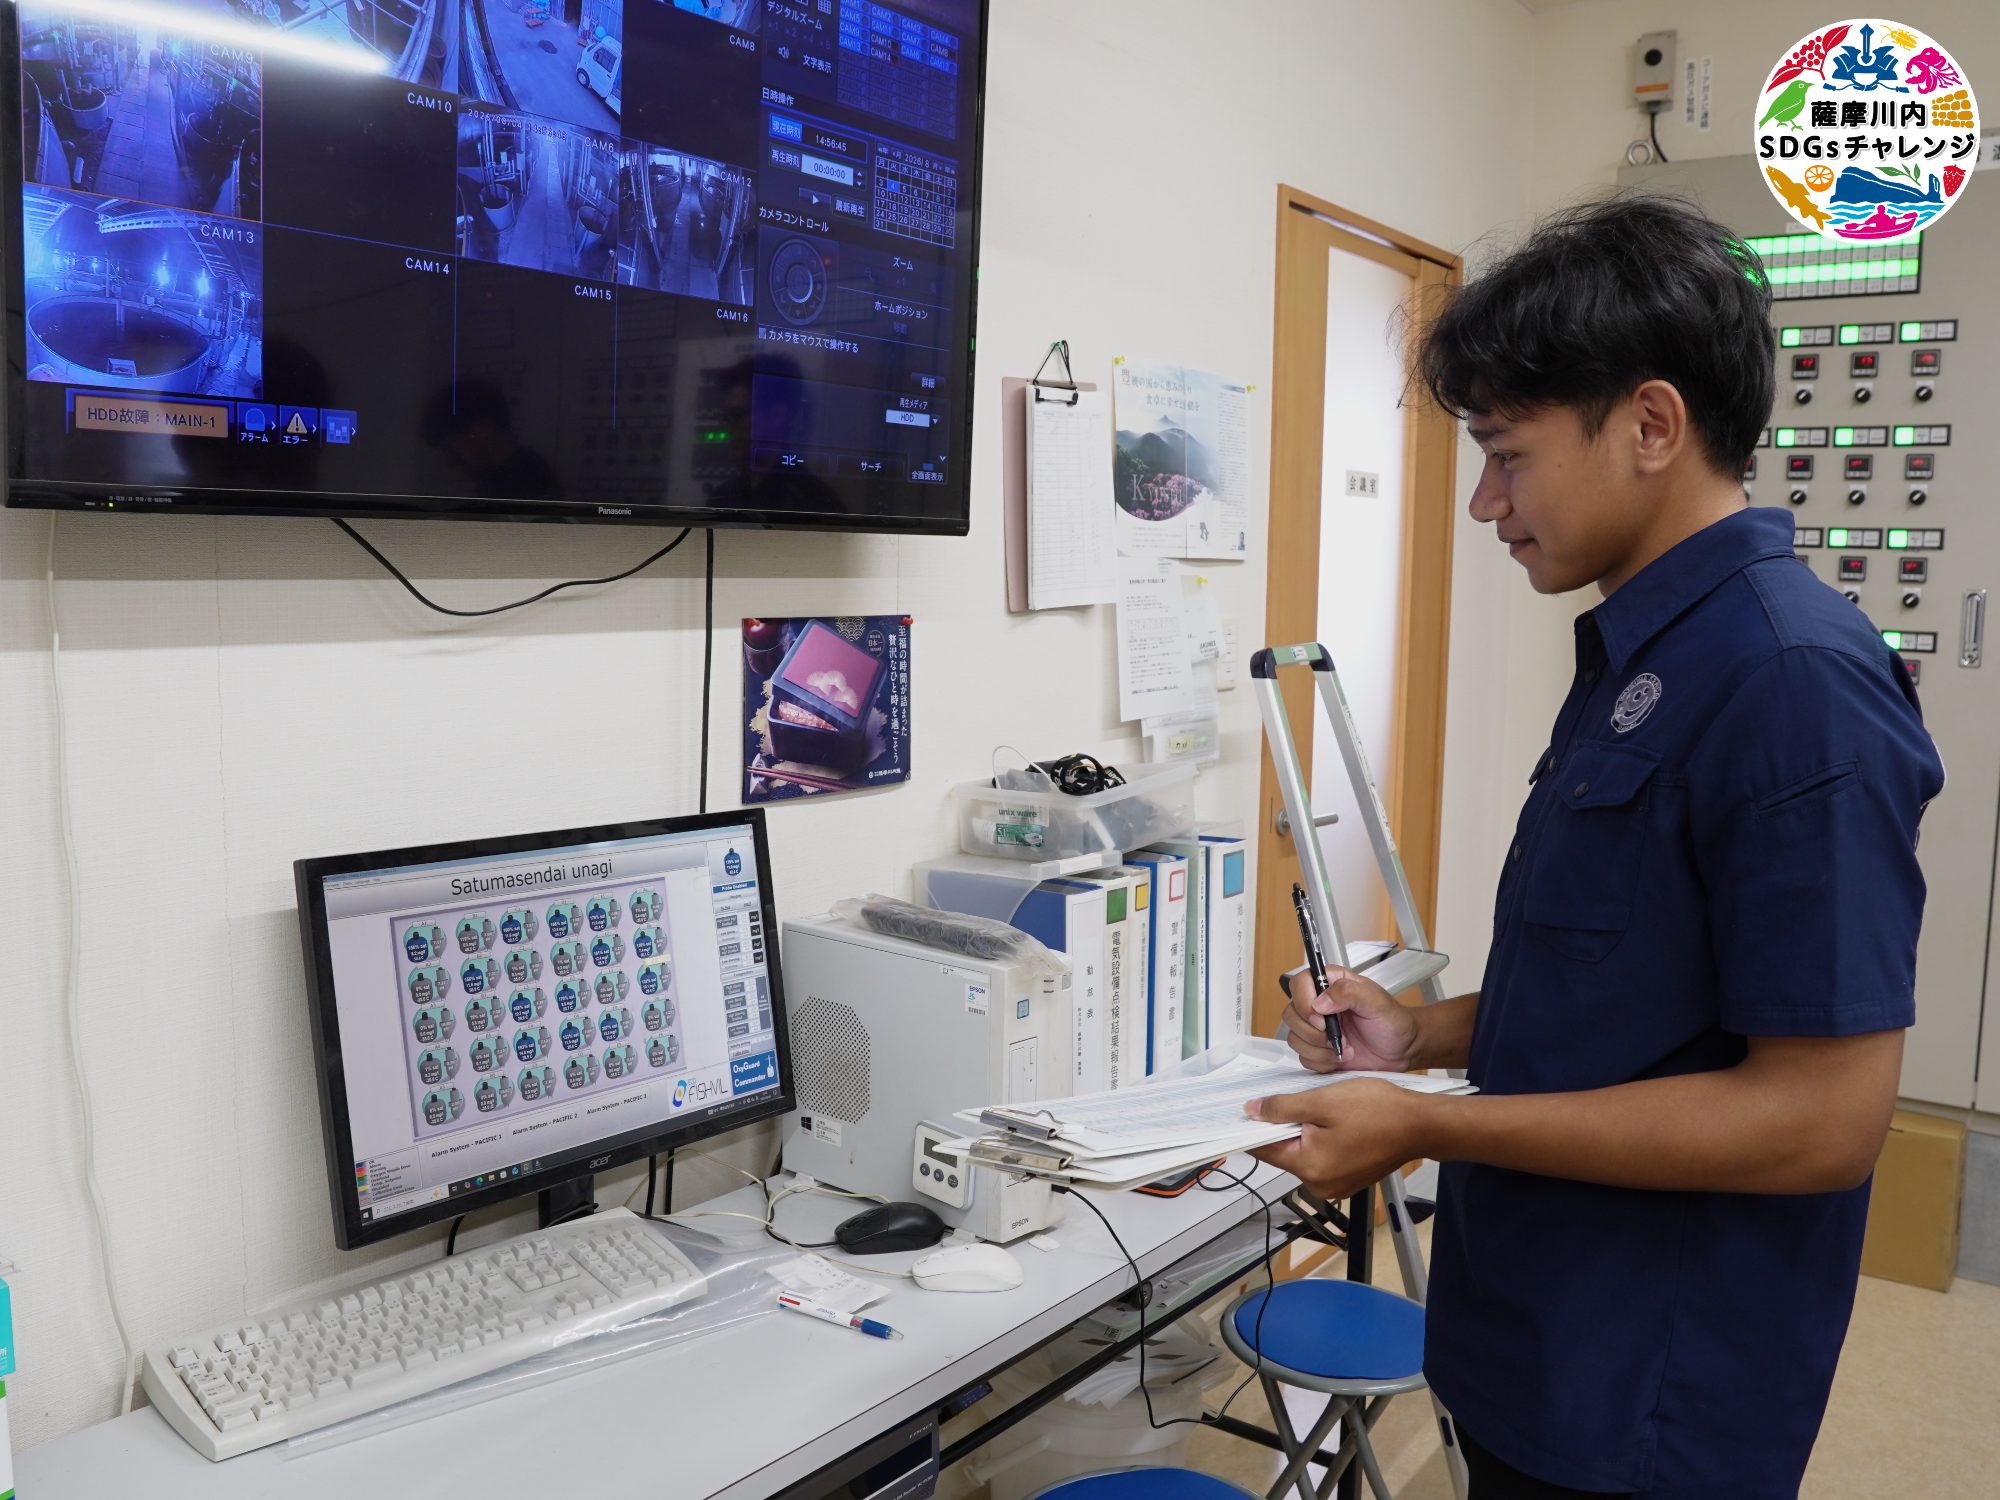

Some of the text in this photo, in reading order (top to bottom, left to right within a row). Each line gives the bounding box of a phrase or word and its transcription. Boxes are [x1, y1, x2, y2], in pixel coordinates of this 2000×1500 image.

[767, 1, 822, 30] デジタルズーム
[872, 6, 890, 21] CAM2
[902, 19, 920, 33] CAM3
[730, 35, 755, 51] CAM8
[871, 34, 891, 48] CAM10
[210, 44, 253, 64] CAM9
[871, 48, 890, 62] CAM14
[803, 55, 832, 73] 文字表示
[407, 92, 451, 112] CAM10
[762, 88, 794, 107] 日時操作
[773, 119, 801, 138] 現在時刻
[584, 137, 614, 153] CAM6
[816, 135, 846, 151] 14:56:45
[772, 149, 799, 167] 再生時刻
[814, 163, 846, 179] 00:00:00
[720, 171, 752, 187] CAM12
[877, 189, 885, 197] 10
[889, 192, 896, 200] 11
[836, 200, 865, 217] 最新再生
[759, 207, 829, 232] カメラコントロール
[876, 220, 883, 228] 31
[201, 225, 254, 244] CAM13
[405, 258, 449, 274] CAM14
[893, 258, 913, 270] ズーム
[575, 285, 611, 300] CAM15
[717, 308, 748, 322] CAM16
[875, 301, 928, 319] ホームポジション
[769, 330, 858, 353] カメラをマウスで操作する
[922, 377, 935, 388] 詳細
[900, 398, 927, 410] 再生メディア
[901, 413, 914, 422] HDD
[240, 433, 268, 442] アラーム
[283, 436, 308, 444] エラー
[782, 455, 804, 465] コピー
[861, 461, 881, 471] サーチ
[912, 471, 943, 481] 全画面表示
[599, 507, 631, 515] Panasonic
[898, 625, 908, 737] 至福の時間が詰まった
[889, 634, 899, 763] 贅沢なひと時を過ごそう
[999, 808, 1015, 816] unix
[451, 860, 613, 896] Satumasendai unagi
[970, 986, 985, 994] EPSON
[733, 1061, 760, 1073] OxyGuard
[735, 1074, 766, 1087] Commander
[587, 1106, 601, 1114] Alarm
[602, 1102, 620, 1111] System
[624, 1095, 643, 1104] PACIFIC
[512, 1126, 528, 1135] Alarm
[530, 1122, 548, 1132] System
[552, 1115, 573, 1124] PACIFIC
[432, 1148, 448, 1158] Alarm
[450, 1142, 469, 1154] System
[475, 1136, 496, 1146] PACIFIC
[590, 1154, 611, 1169] acer
[1011, 1217, 1029, 1229] EPSON
